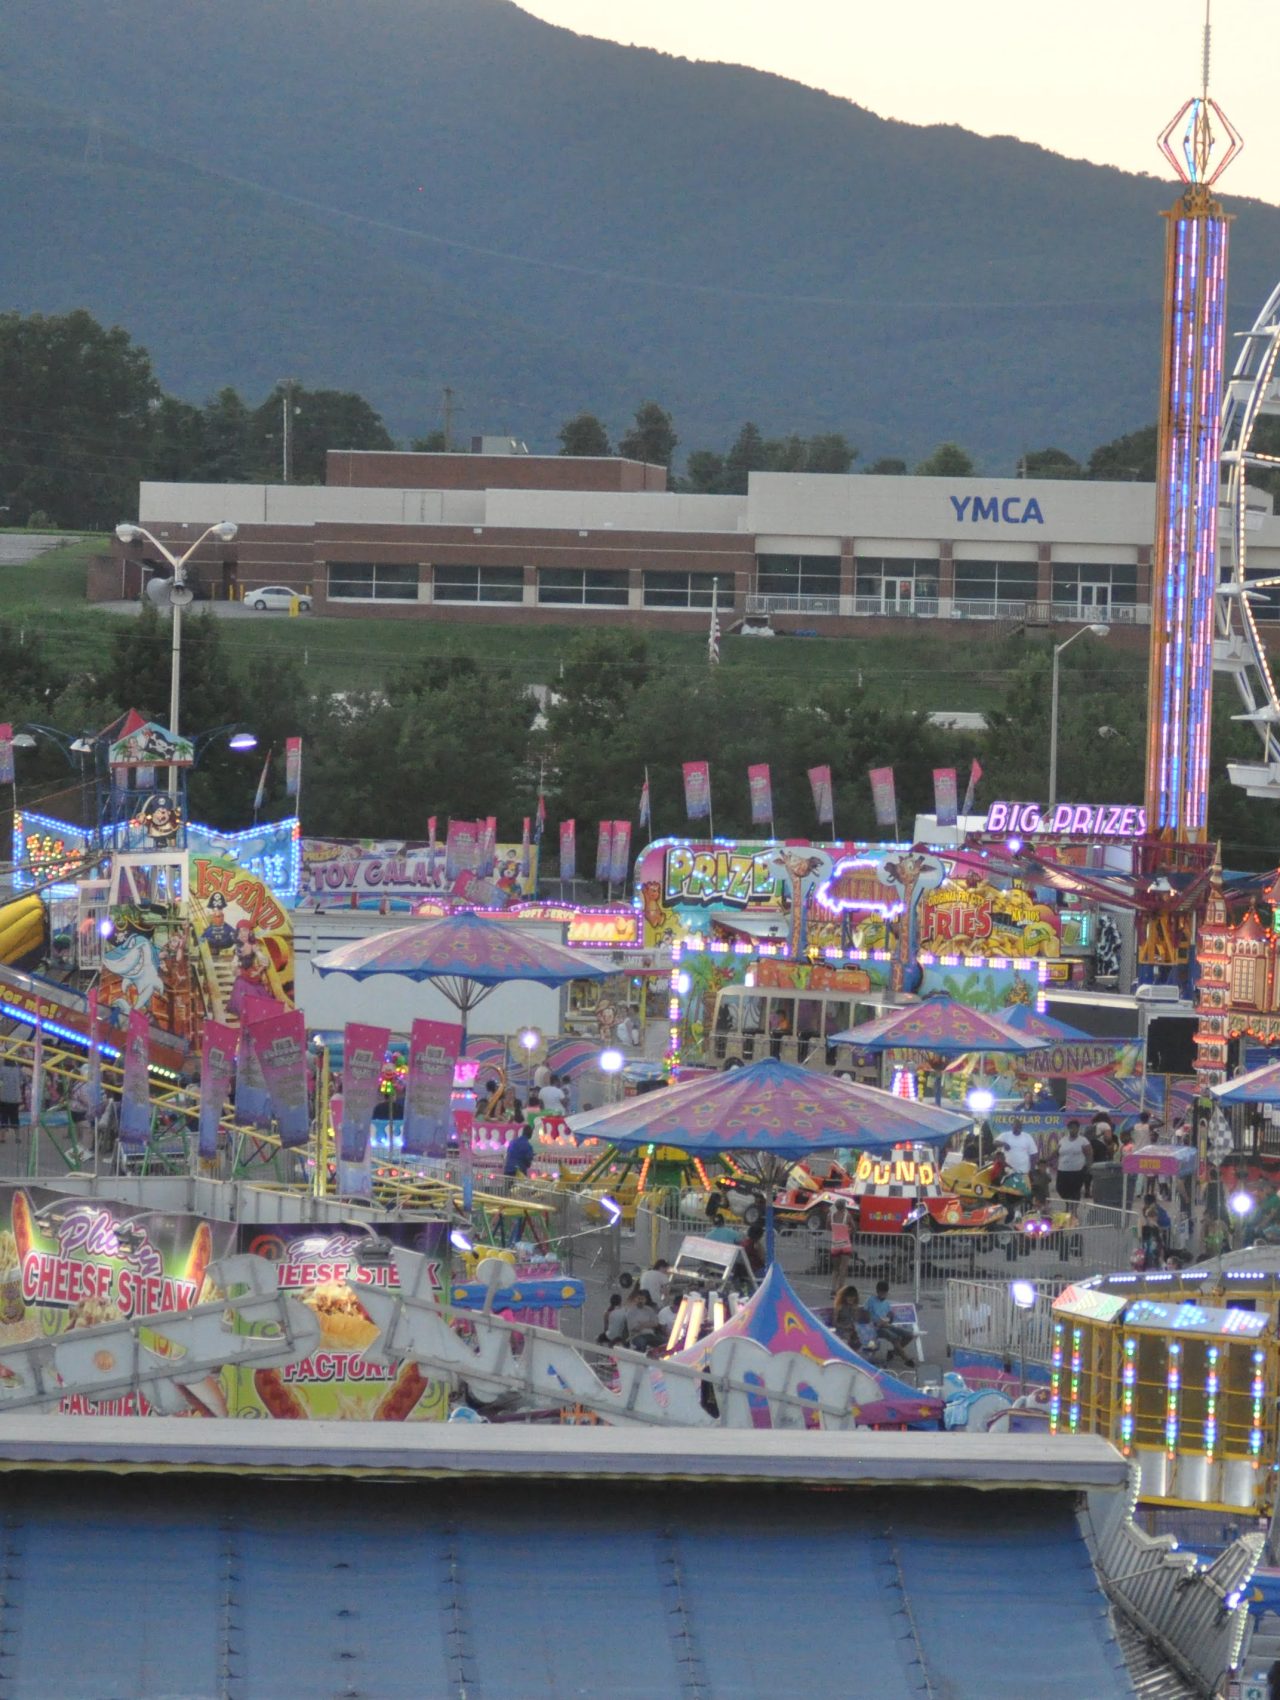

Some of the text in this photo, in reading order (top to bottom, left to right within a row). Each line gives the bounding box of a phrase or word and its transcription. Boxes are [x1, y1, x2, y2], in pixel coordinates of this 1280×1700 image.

[950, 495, 1044, 525] YMCA
[985, 802, 1147, 837] BIG PRIZES
[193, 858, 286, 930] ISLAND
[312, 863, 360, 891] TOY
[518, 908, 543, 919] SOFT
[922, 900, 992, 940] FRIES
[22, 1253, 199, 1318] CHEESE STEAK
